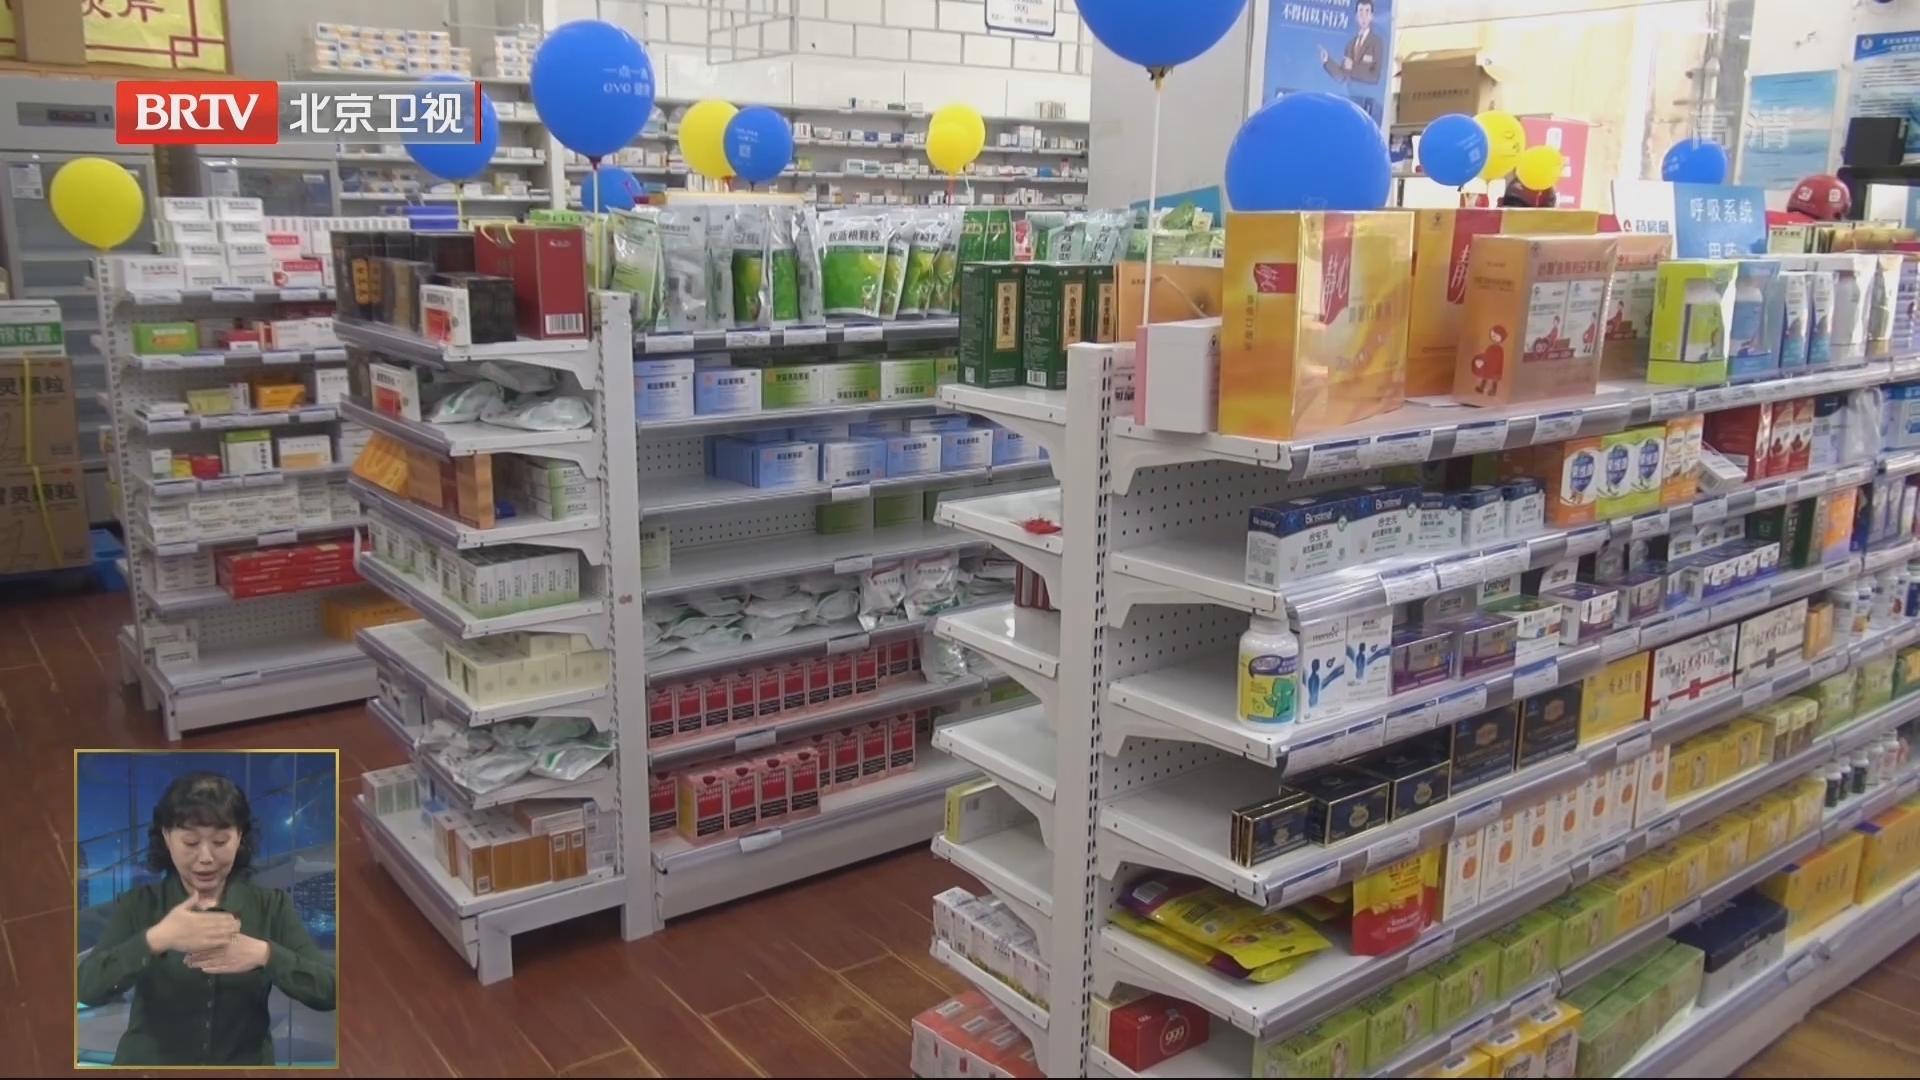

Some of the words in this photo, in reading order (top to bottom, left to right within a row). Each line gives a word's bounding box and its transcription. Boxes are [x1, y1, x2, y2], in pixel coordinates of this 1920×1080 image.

[1689, 196, 1754, 224] 呼吸系统
[828, 229, 881, 243] 板蓝根颗粒
[1164, 1025, 1185, 1046] 999
